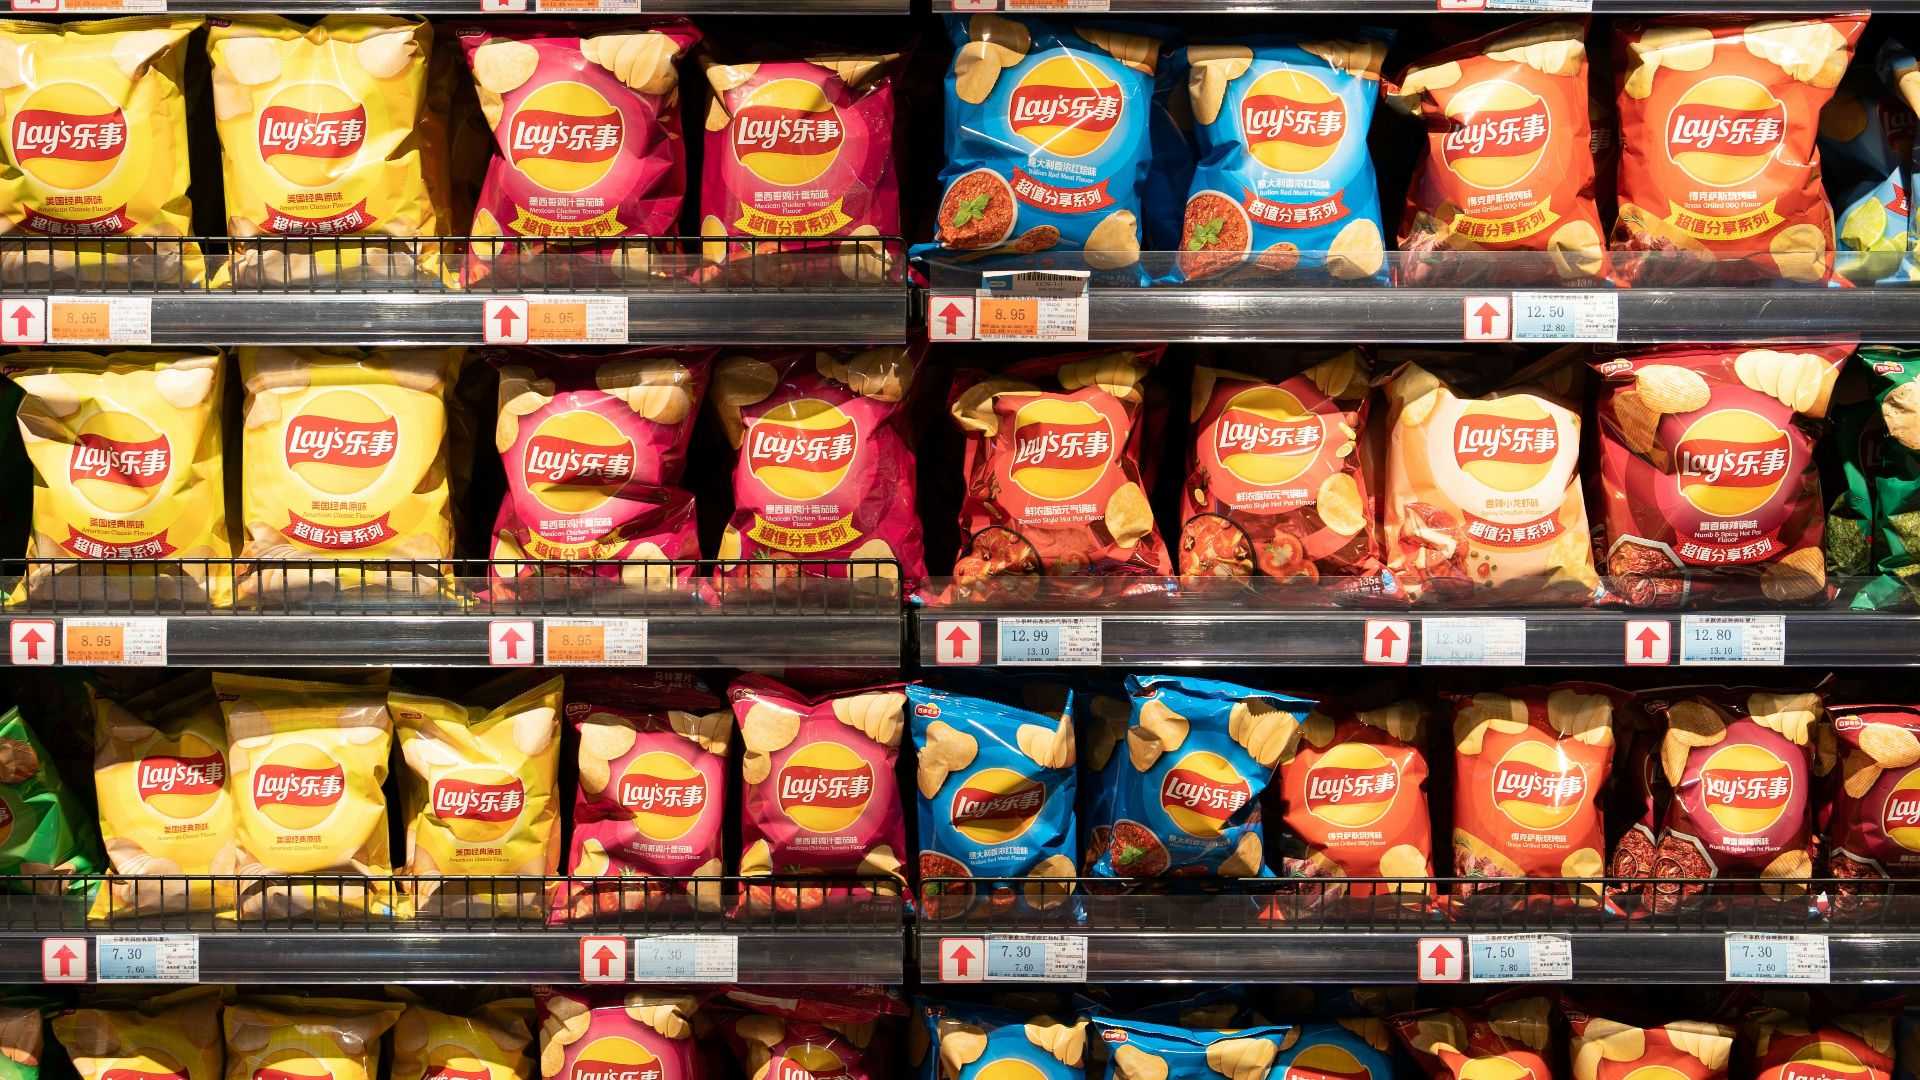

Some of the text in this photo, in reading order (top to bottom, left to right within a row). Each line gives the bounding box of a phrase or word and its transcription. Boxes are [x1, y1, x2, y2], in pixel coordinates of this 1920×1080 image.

[287, 192, 343, 203] 美国经典原味
[1014, 177, 1101, 207] 超值分享系列
[1467, 189, 1533, 207] 得克萨斯烧烤味
[1688, 191, 1758, 201] 得克萨斯烧烤味
[46, 196, 104, 206] 美国经典原味
[529, 196, 605, 207] 墨西哥鸡汁番茄味
[1248, 200, 1338, 223] 超值分享系列
[1455, 210, 1546, 236] 超值分享系列
[1675, 210, 1769, 236] 超值分享系列
[543, 312, 574, 324] 8.95
[995, 309, 1026, 321] 8.95
[1527, 306, 1565, 318] 12.50
[67, 312, 97, 325] 8.95
[1542, 324, 1566, 332] 12.80
[311, 501, 367, 512] 美国经典原味
[1230, 503, 1254, 511] Tomato
[1254, 502, 1270, 510] Style
[1271, 501, 1283, 509] Hot
[1296, 499, 1317, 507] Flavor
[90, 518, 145, 529] 美国经典原味
[1017, 517, 1040, 525] Tomato
[1041, 516, 1057, 525] Style
[1083, 514, 1104, 522] Flavor
[293, 520, 383, 546] 超值分享系列
[759, 523, 848, 547] 超值分享系列
[1467, 519, 1554, 543] 超值分享系列
[1720, 531, 1738, 539] Spicy
[1680, 539, 1771, 563] 超值分享系列
[81, 635, 112, 647] 8.95
[562, 635, 592, 646] 8.95
[1011, 630, 1048, 642] 12.99
[1435, 633, 1471, 645] 12.80
[1694, 629, 1731, 641] 12.80
[1027, 648, 1049, 656] 13.10
[1710, 647, 1732, 655] 13.10
[113, 948, 142, 960] 7.30
[653, 949, 682, 960] 7.30
[1001, 945, 1031, 958] 7.30
[1485, 946, 1515, 959] 7.50
[1743, 946, 1773, 958] 7.30
[127, 966, 145, 974] 7.60
[1015, 963, 1034, 972] 7.60
[1500, 964, 1518, 972] 7.80
[1758, 963, 1776, 972] 7.60
